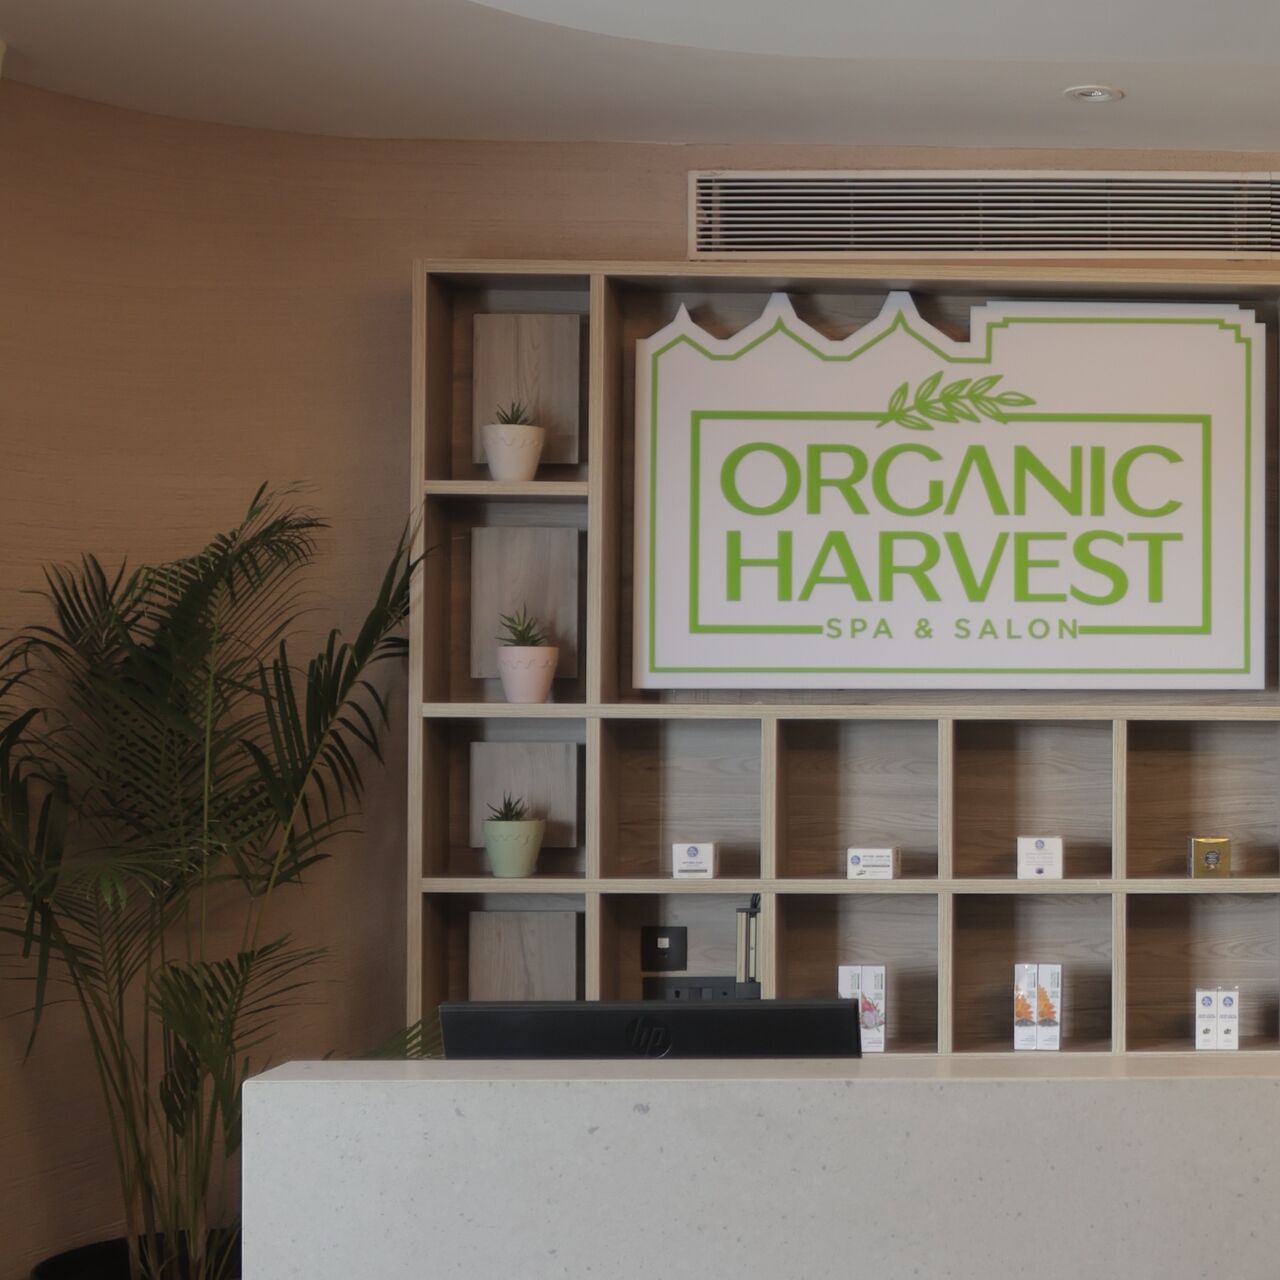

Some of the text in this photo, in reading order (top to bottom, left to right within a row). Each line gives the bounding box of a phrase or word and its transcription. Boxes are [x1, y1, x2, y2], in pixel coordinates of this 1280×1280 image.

[720, 442, 1184, 518] ORGANIC
[725, 529, 1184, 606] HARVEST
[825, 617, 1079, 640] SPA & SALON
[631, 1015, 667, 1057] hp
